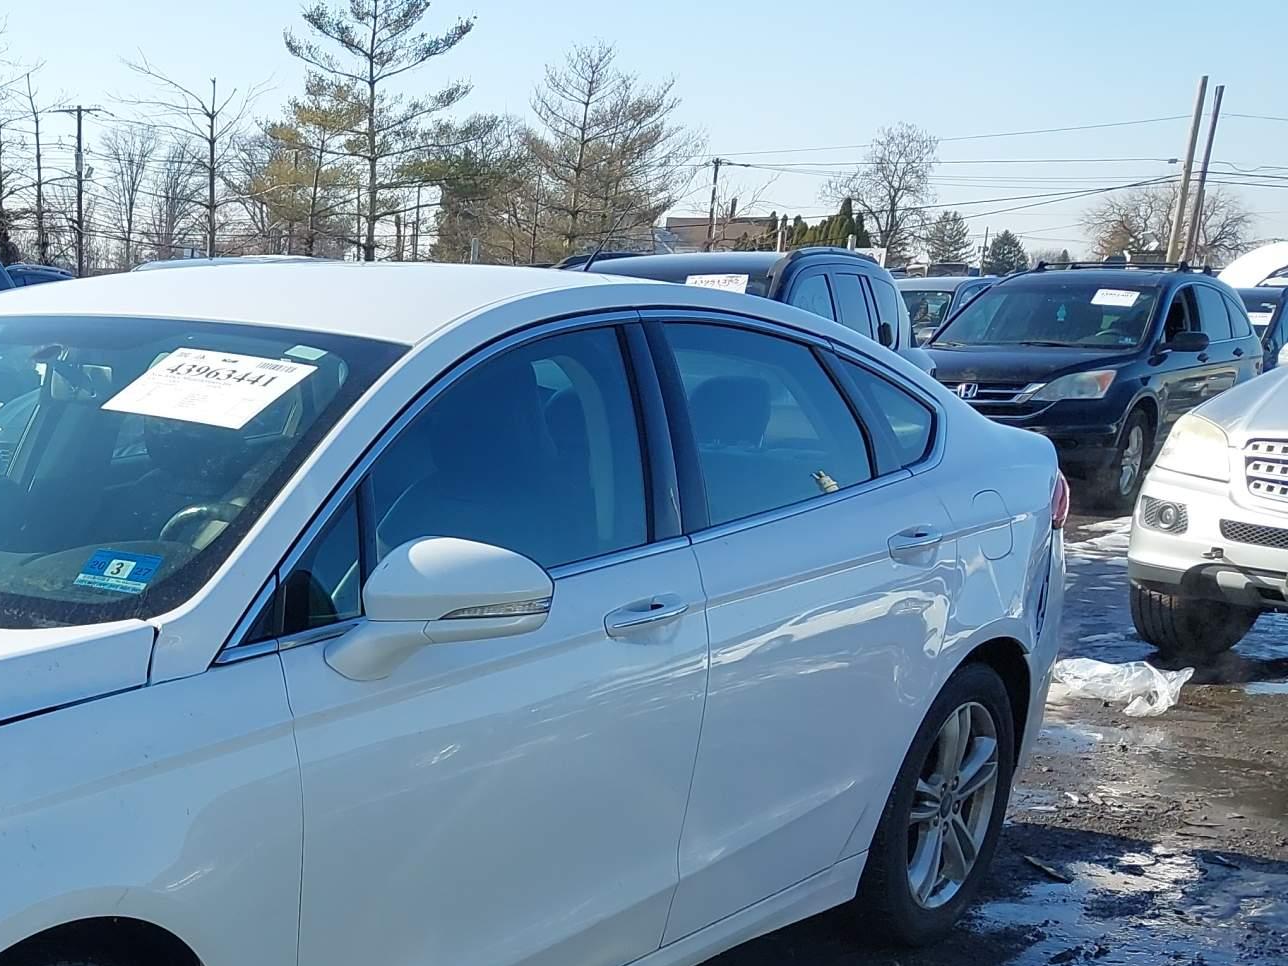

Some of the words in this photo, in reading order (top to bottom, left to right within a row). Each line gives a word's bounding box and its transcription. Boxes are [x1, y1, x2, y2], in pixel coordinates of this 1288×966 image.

[166, 362, 278, 388] 43963441
[89, 560, 105, 571] 20
[110, 562, 124, 576] 3
